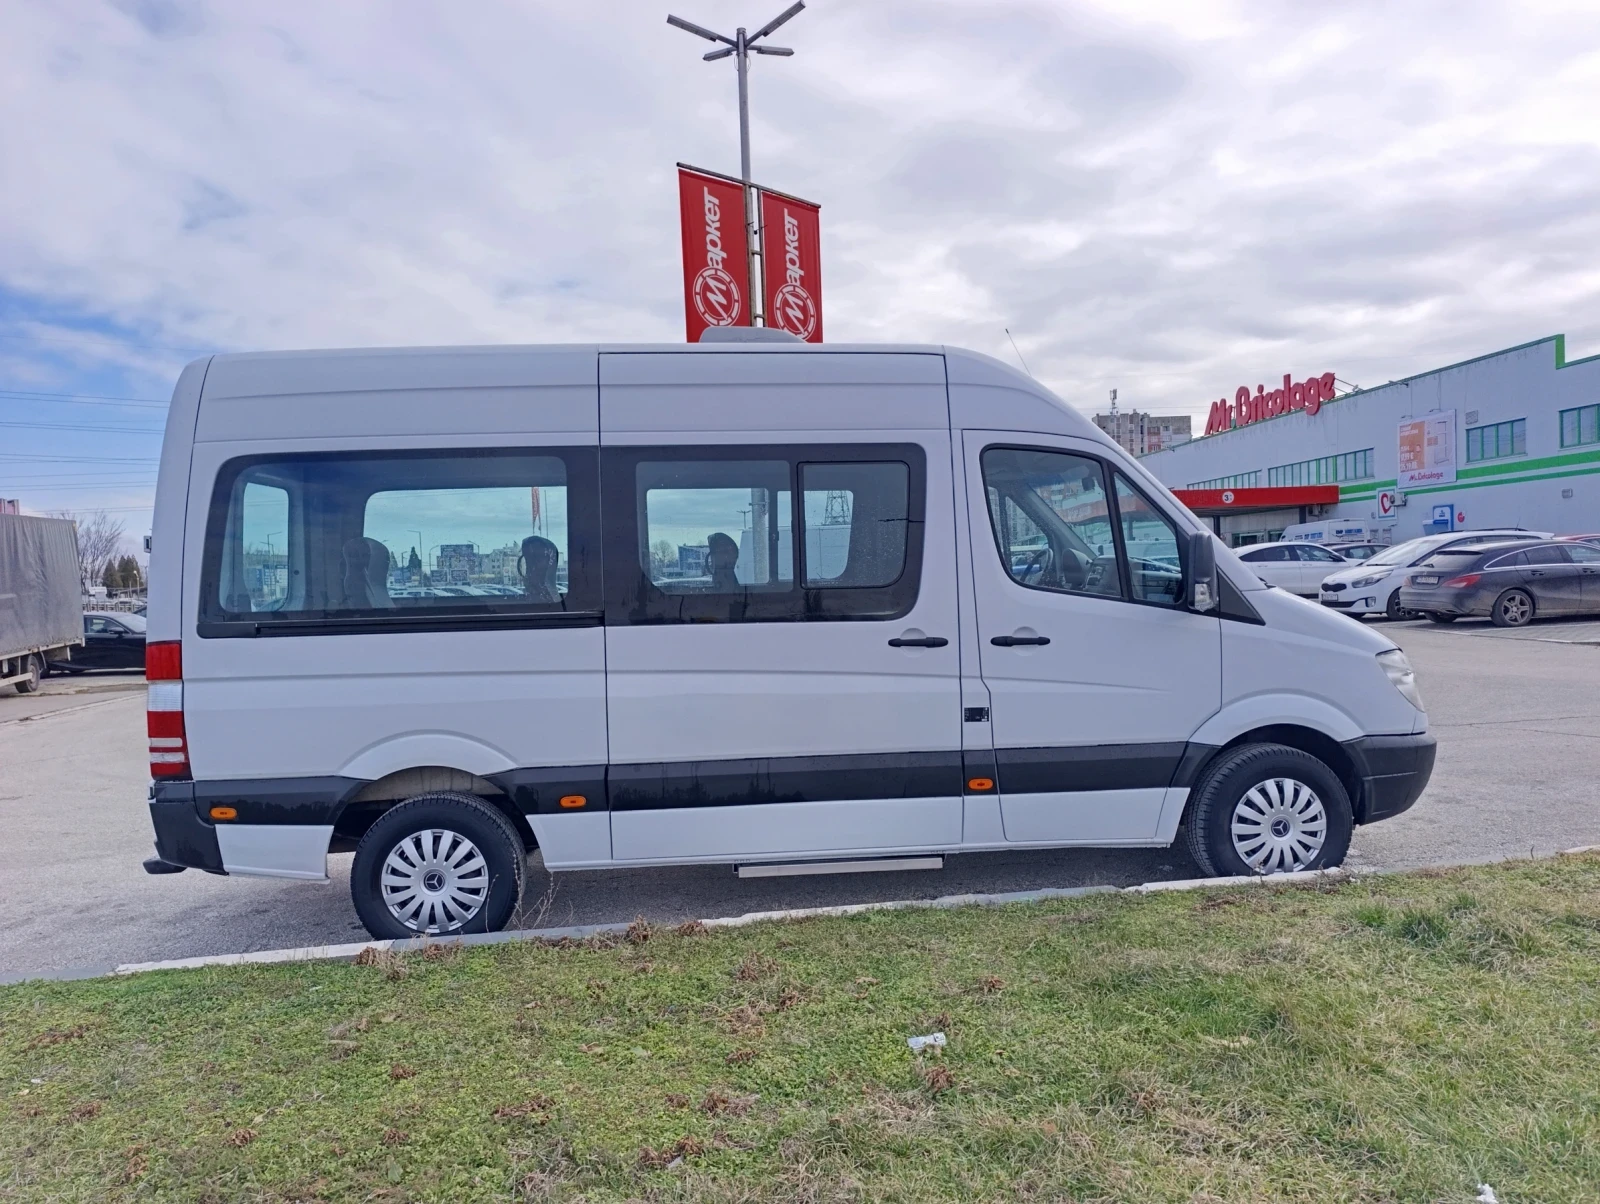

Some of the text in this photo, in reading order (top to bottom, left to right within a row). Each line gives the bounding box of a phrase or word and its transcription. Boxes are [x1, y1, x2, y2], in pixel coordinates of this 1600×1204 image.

[697, 187, 735, 324] Маркет
[779, 208, 811, 337] Маркет
[1235, 372, 1336, 427] Bricolage
